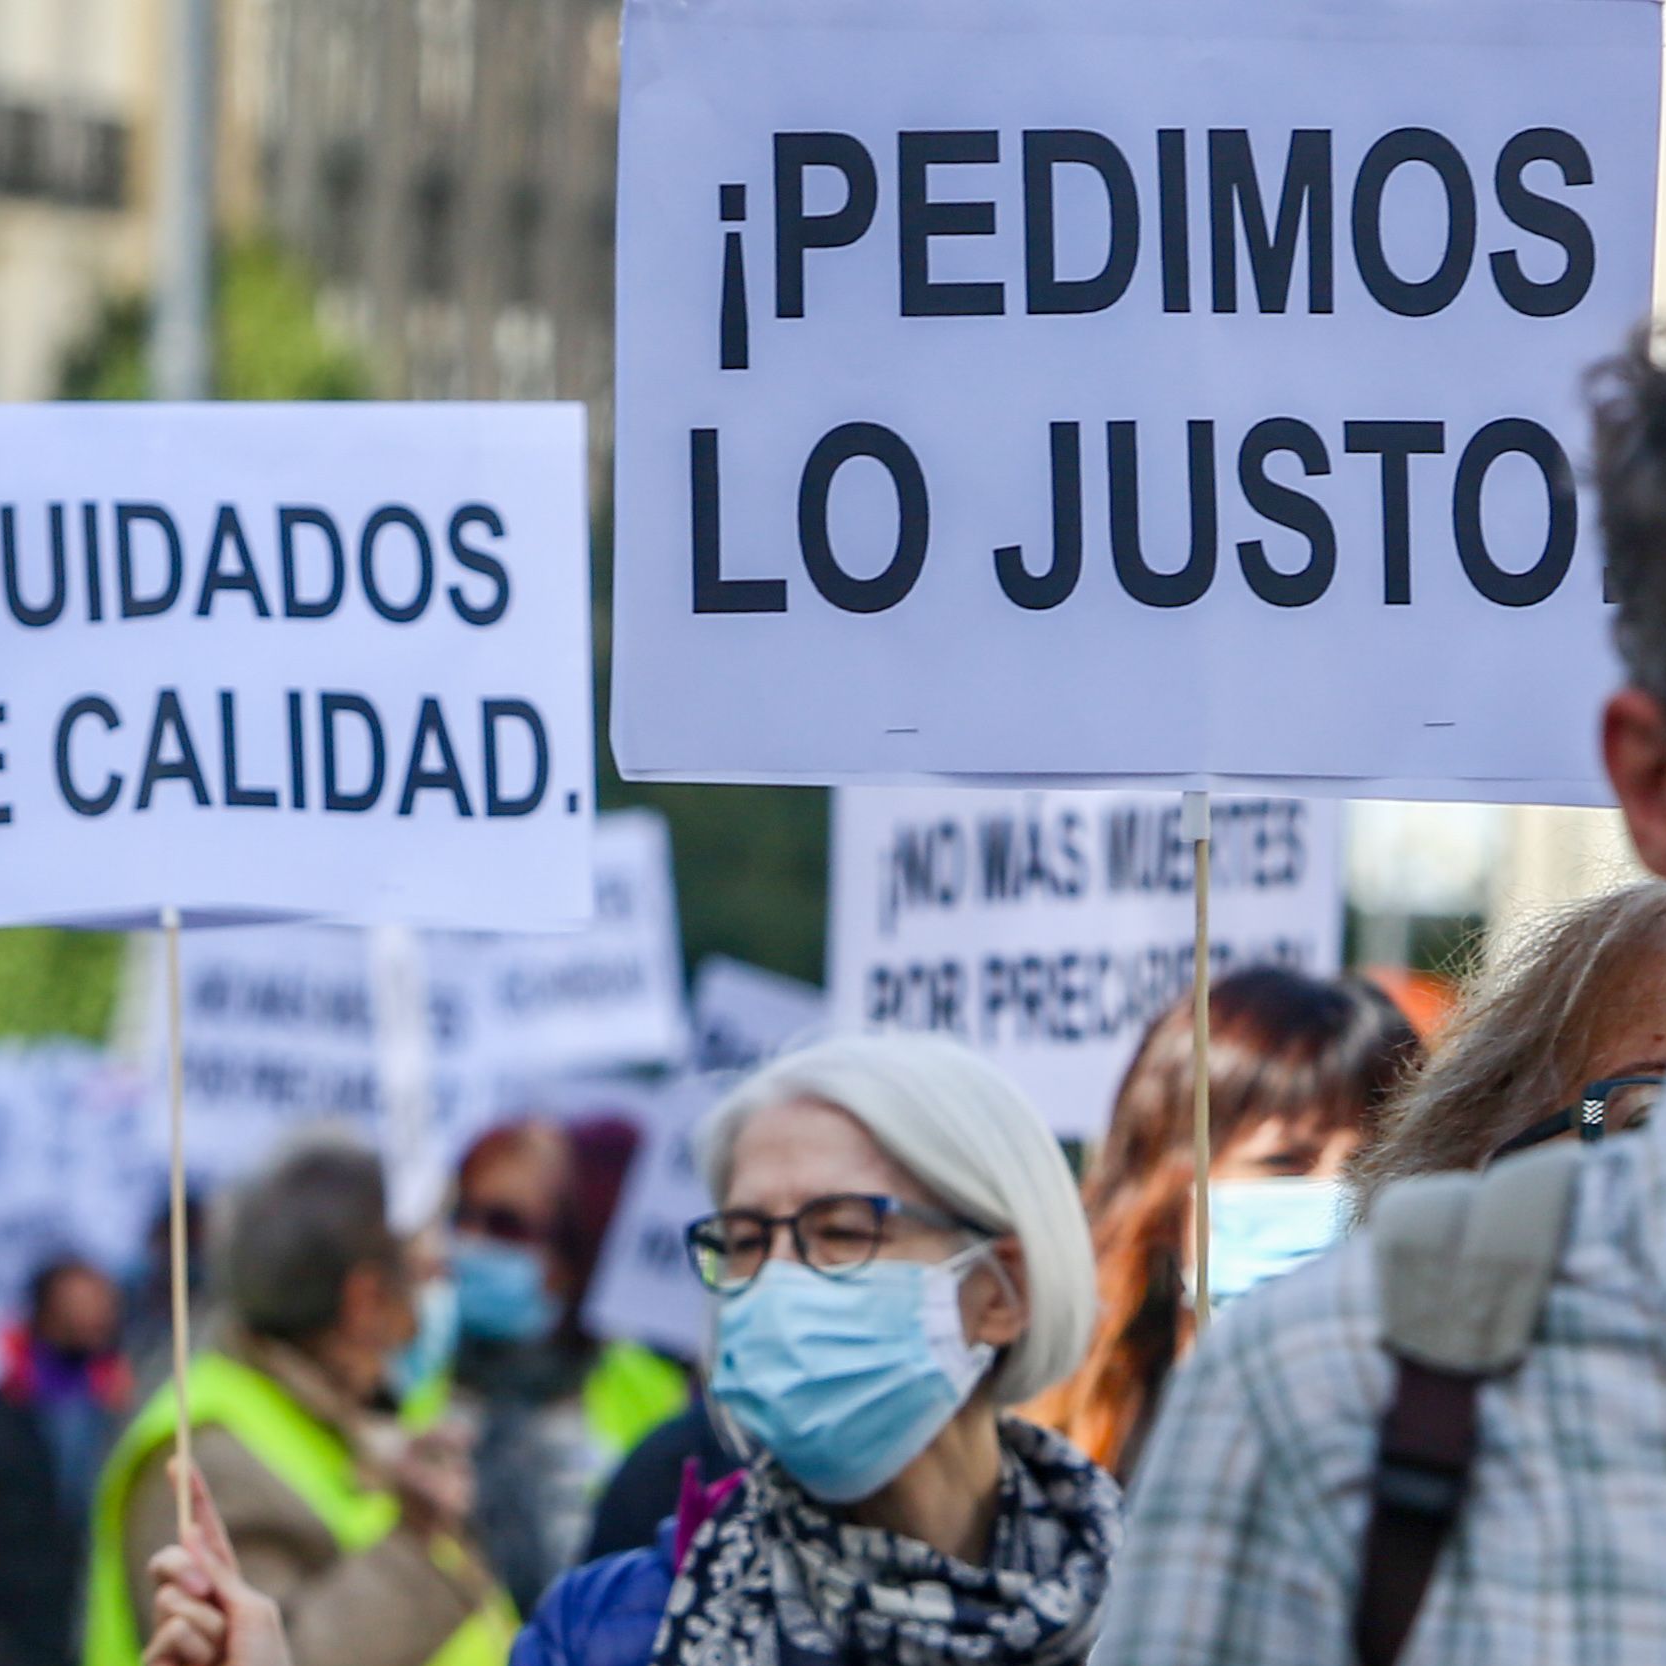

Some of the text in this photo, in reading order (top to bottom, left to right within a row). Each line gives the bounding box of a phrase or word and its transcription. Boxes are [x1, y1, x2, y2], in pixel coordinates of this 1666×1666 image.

[719, 126, 1596, 370] ¡PEDIMOS
[690, 416, 1625, 615] LO JUSTO
[54, 687, 580, 818] CALIDAD.
[863, 960, 969, 1034] POR
